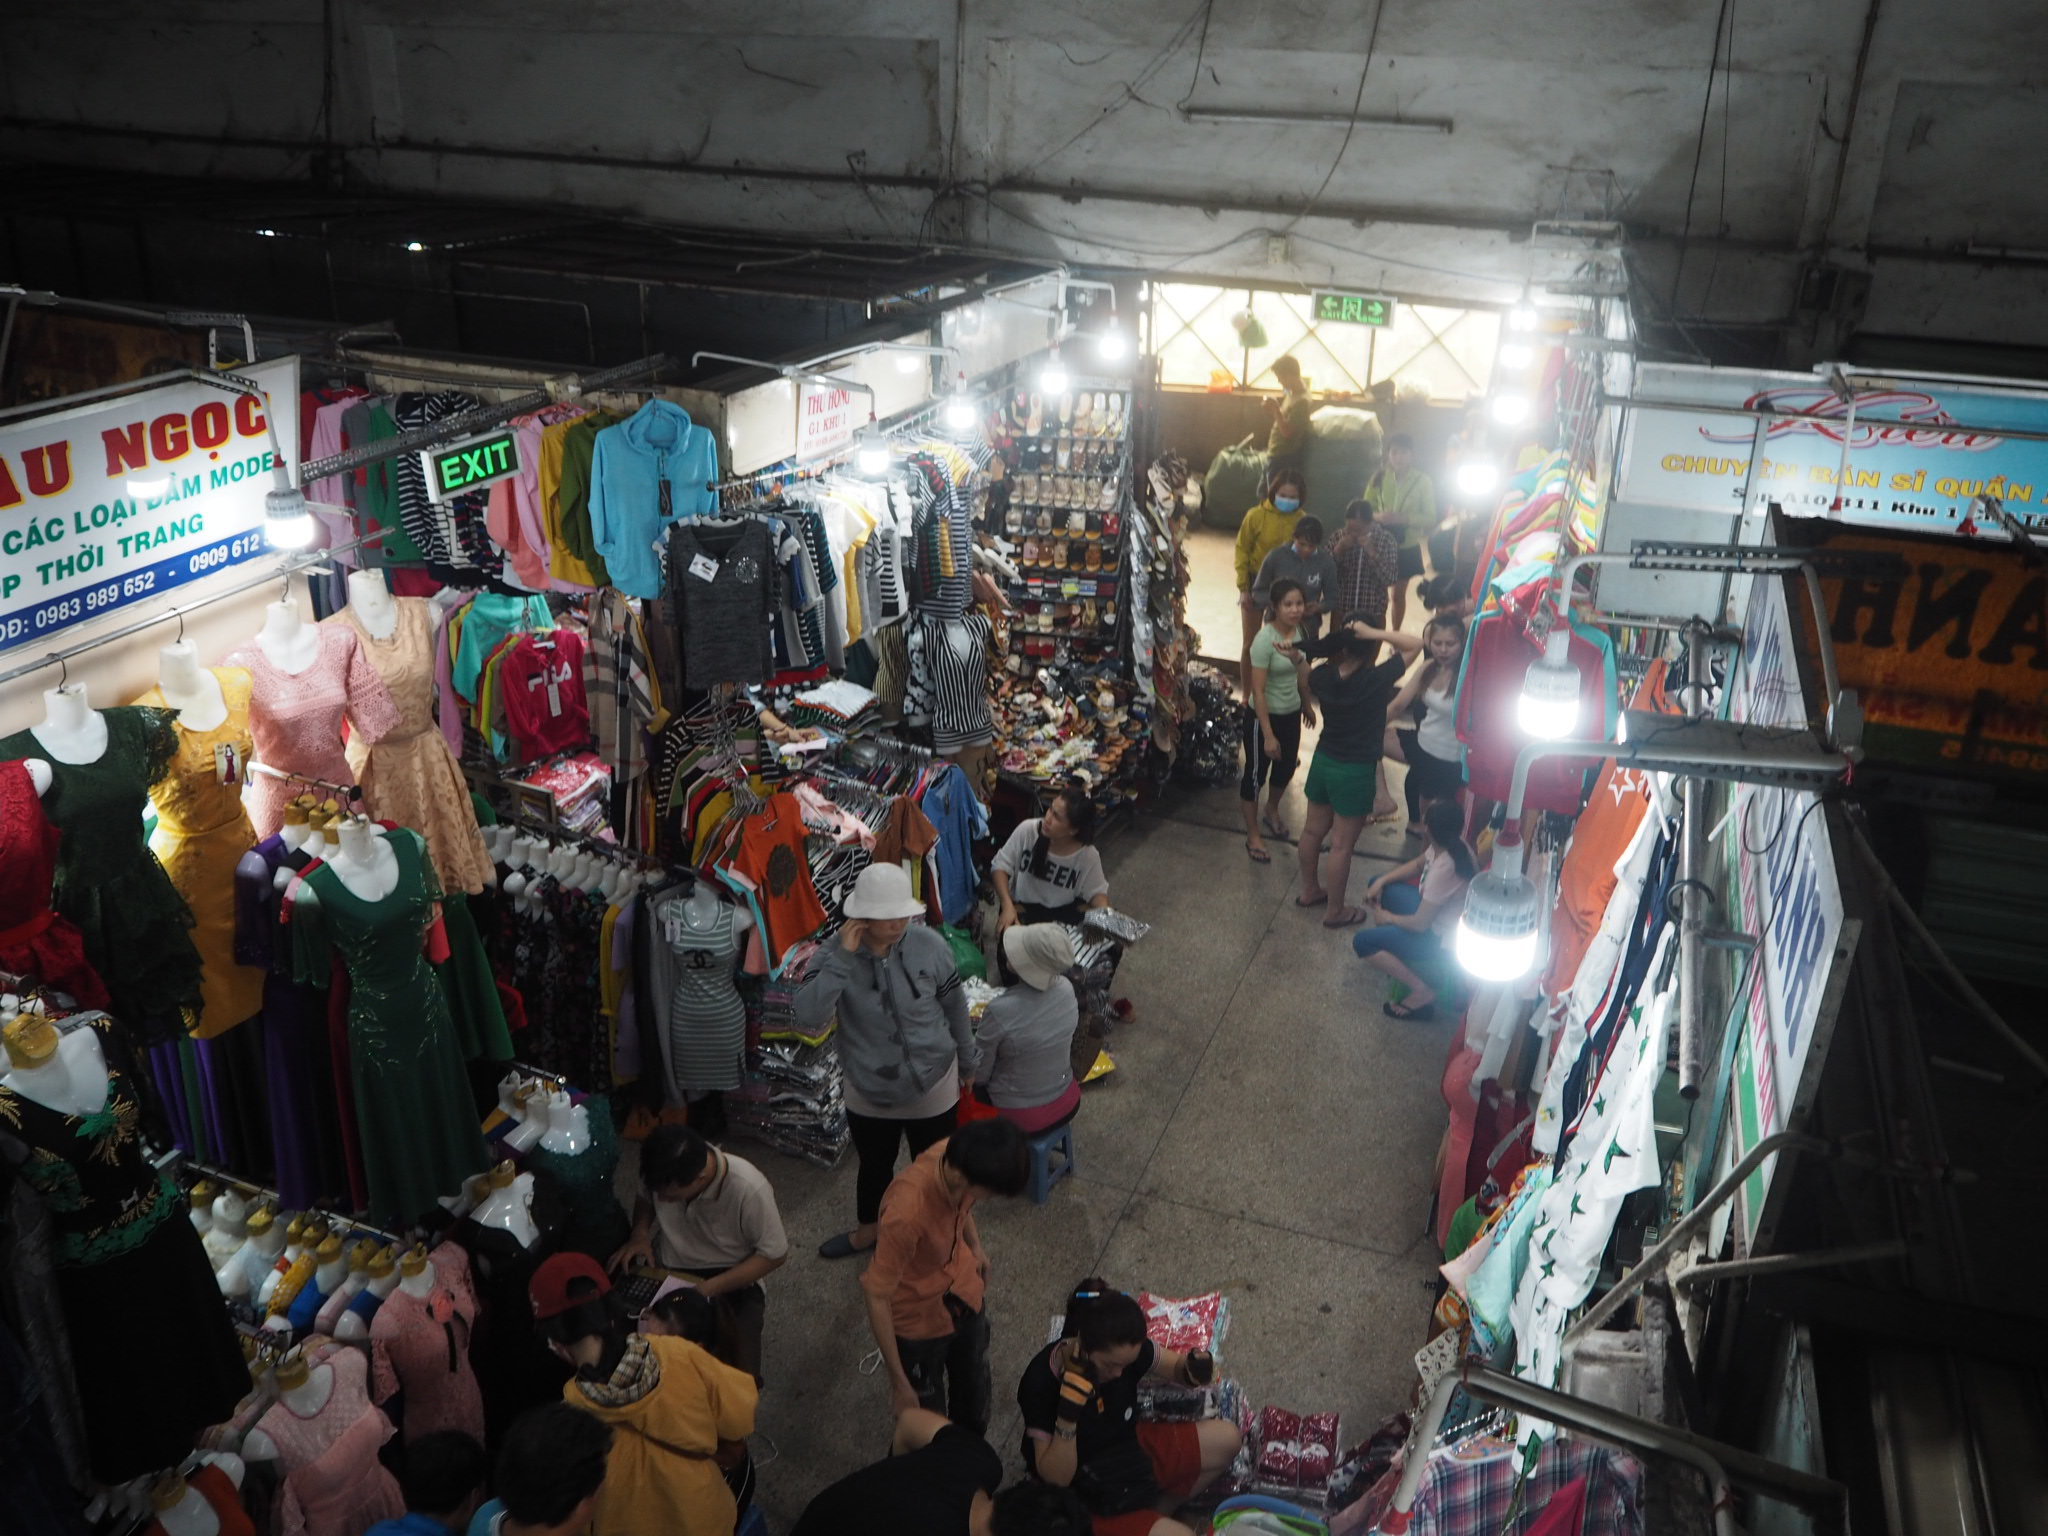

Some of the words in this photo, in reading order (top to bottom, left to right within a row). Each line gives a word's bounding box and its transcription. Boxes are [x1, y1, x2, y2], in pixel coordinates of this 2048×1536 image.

[101, 392, 271, 478] NGỌC
[441, 440, 510, 489] EXIT
[2, 517, 65, 556] CÁC
[74, 494, 137, 534] LOẠI
[210, 450, 286, 490] MODE
[1891, 501, 1936, 516] Khu
[35, 598, 81, 629] 0983
[86, 584, 118, 611] 989
[124, 571, 155, 597] 652
[189, 544, 228, 573] 0909
[231, 533, 259, 558] 612
[36, 544, 104, 586] THỜI
[117, 513, 203, 558] TRANG
